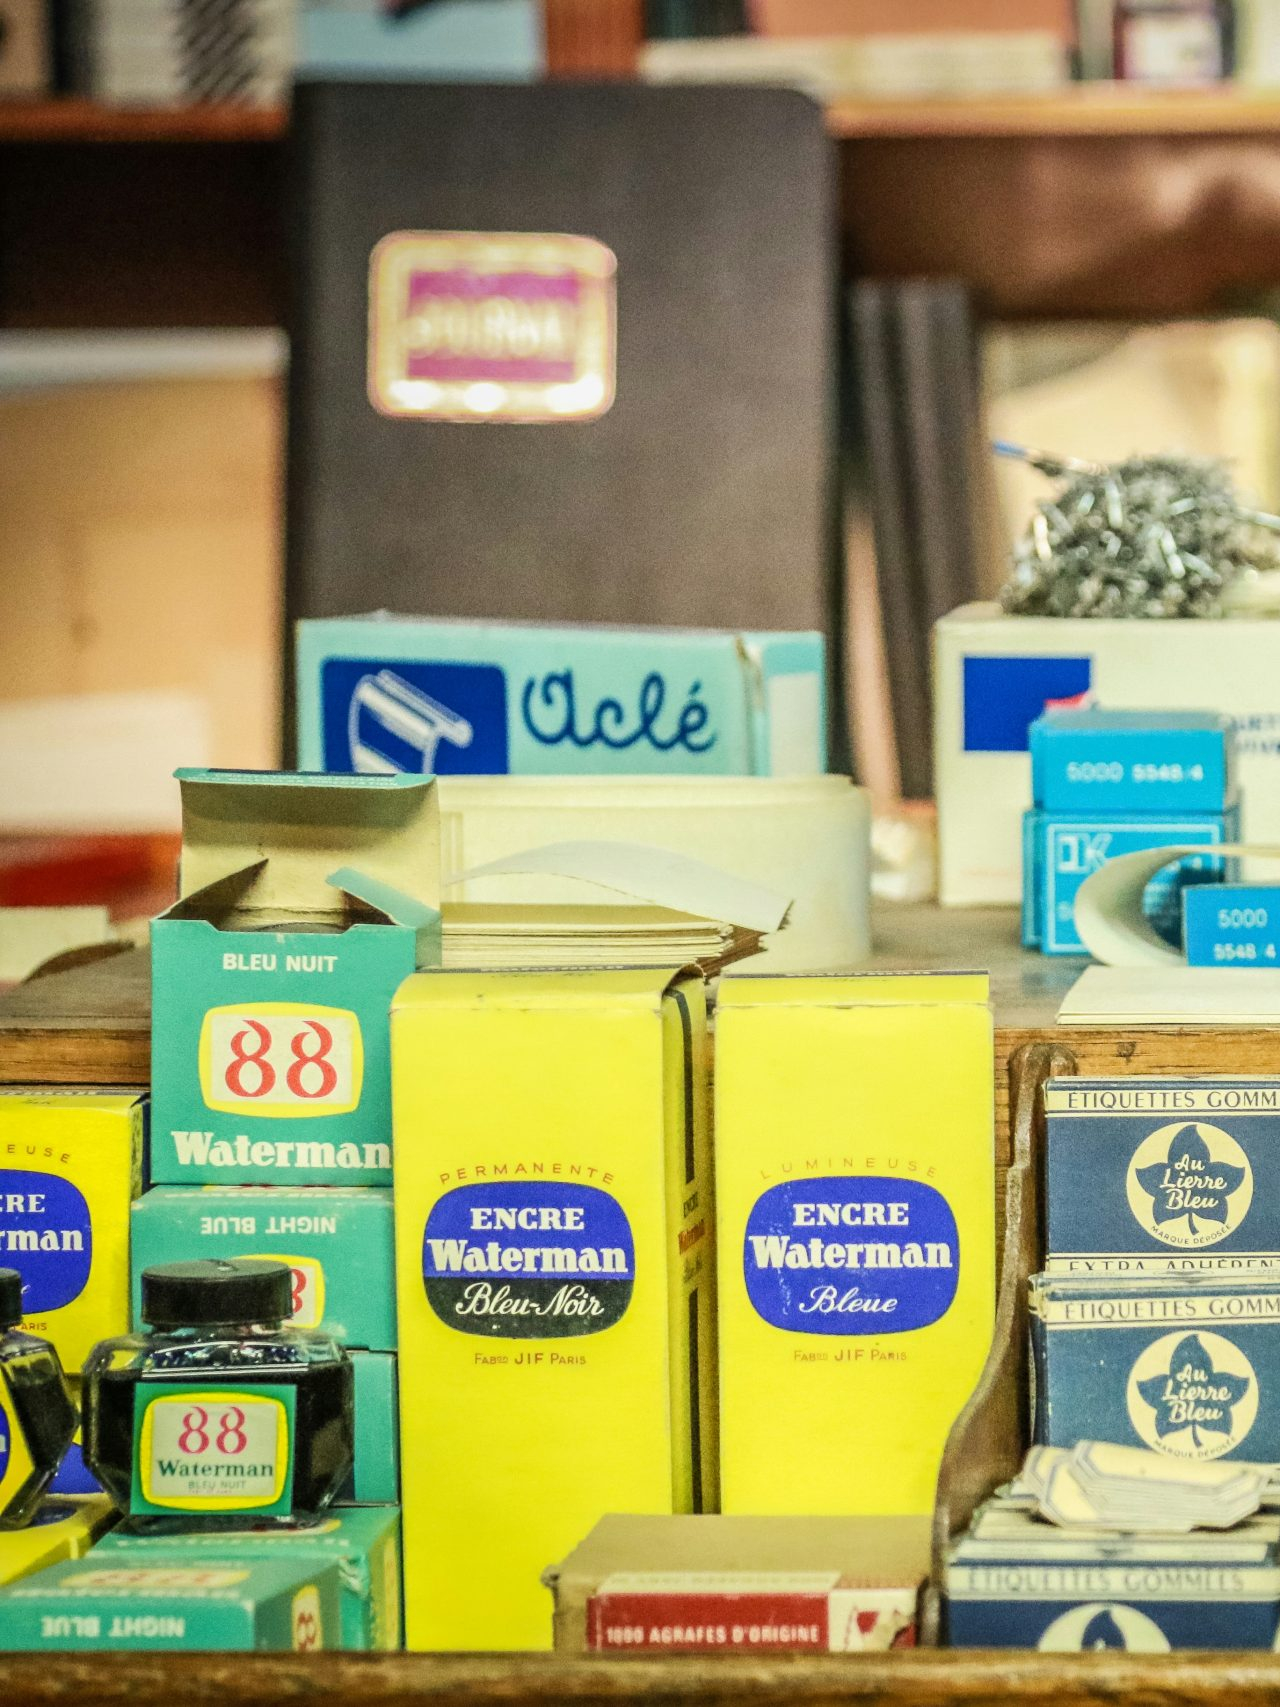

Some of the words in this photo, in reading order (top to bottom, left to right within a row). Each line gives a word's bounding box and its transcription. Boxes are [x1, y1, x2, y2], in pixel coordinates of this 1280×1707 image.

[521, 667, 718, 753] Aclé
[1066, 762, 1124, 782] 5000
[1218, 908, 1268, 928] 5000
[1214, 943, 1256, 960] 5548
[223, 954, 277, 971] BLEU
[286, 955, 338, 972] NUIT
[224, 1019, 338, 1098] 88
[170, 1130, 393, 1169] Waterman
[440, 1162, 615, 1184] PERMANENTE
[760, 1158, 936, 1180] LUMINEUSE
[1174, 1154, 1205, 1172] Au
[1160, 1170, 1227, 1190] Lierre
[1166, 1189, 1219, 1210] Bleu
[470, 1208, 585, 1230] ENCRE
[793, 1202, 909, 1226] ENCRE
[200, 1216, 256, 1234] BLUE
[266, 1216, 336, 1234] NIGHT
[1152, 1225, 1190, 1244] MARQUE
[427, 1238, 628, 1274] Waterman
[749, 1235, 952, 1268] Waterman
[455, 1282, 604, 1316] Bleu-Noir
[799, 1285, 898, 1313] Bleue
[514, 1353, 544, 1364] JIF
[834, 1350, 864, 1361] JIF
[1176, 1363, 1208, 1382] Au
[1163, 1380, 1232, 1401] Lierre
[1168, 1399, 1223, 1423] Bleu
[177, 1406, 247, 1454] 88
[158, 1460, 274, 1477] Waterman
[188, 1480, 216, 1490] BLEU
[220, 1480, 246, 1489] NUIT
[41, 1616, 100, 1638] BLUE
[108, 1616, 186, 1638] NIGHT
[607, 1627, 644, 1644] 1000
[650, 1626, 726, 1643] AGRAFES
[732, 1624, 819, 1643] D'ORIGINE
